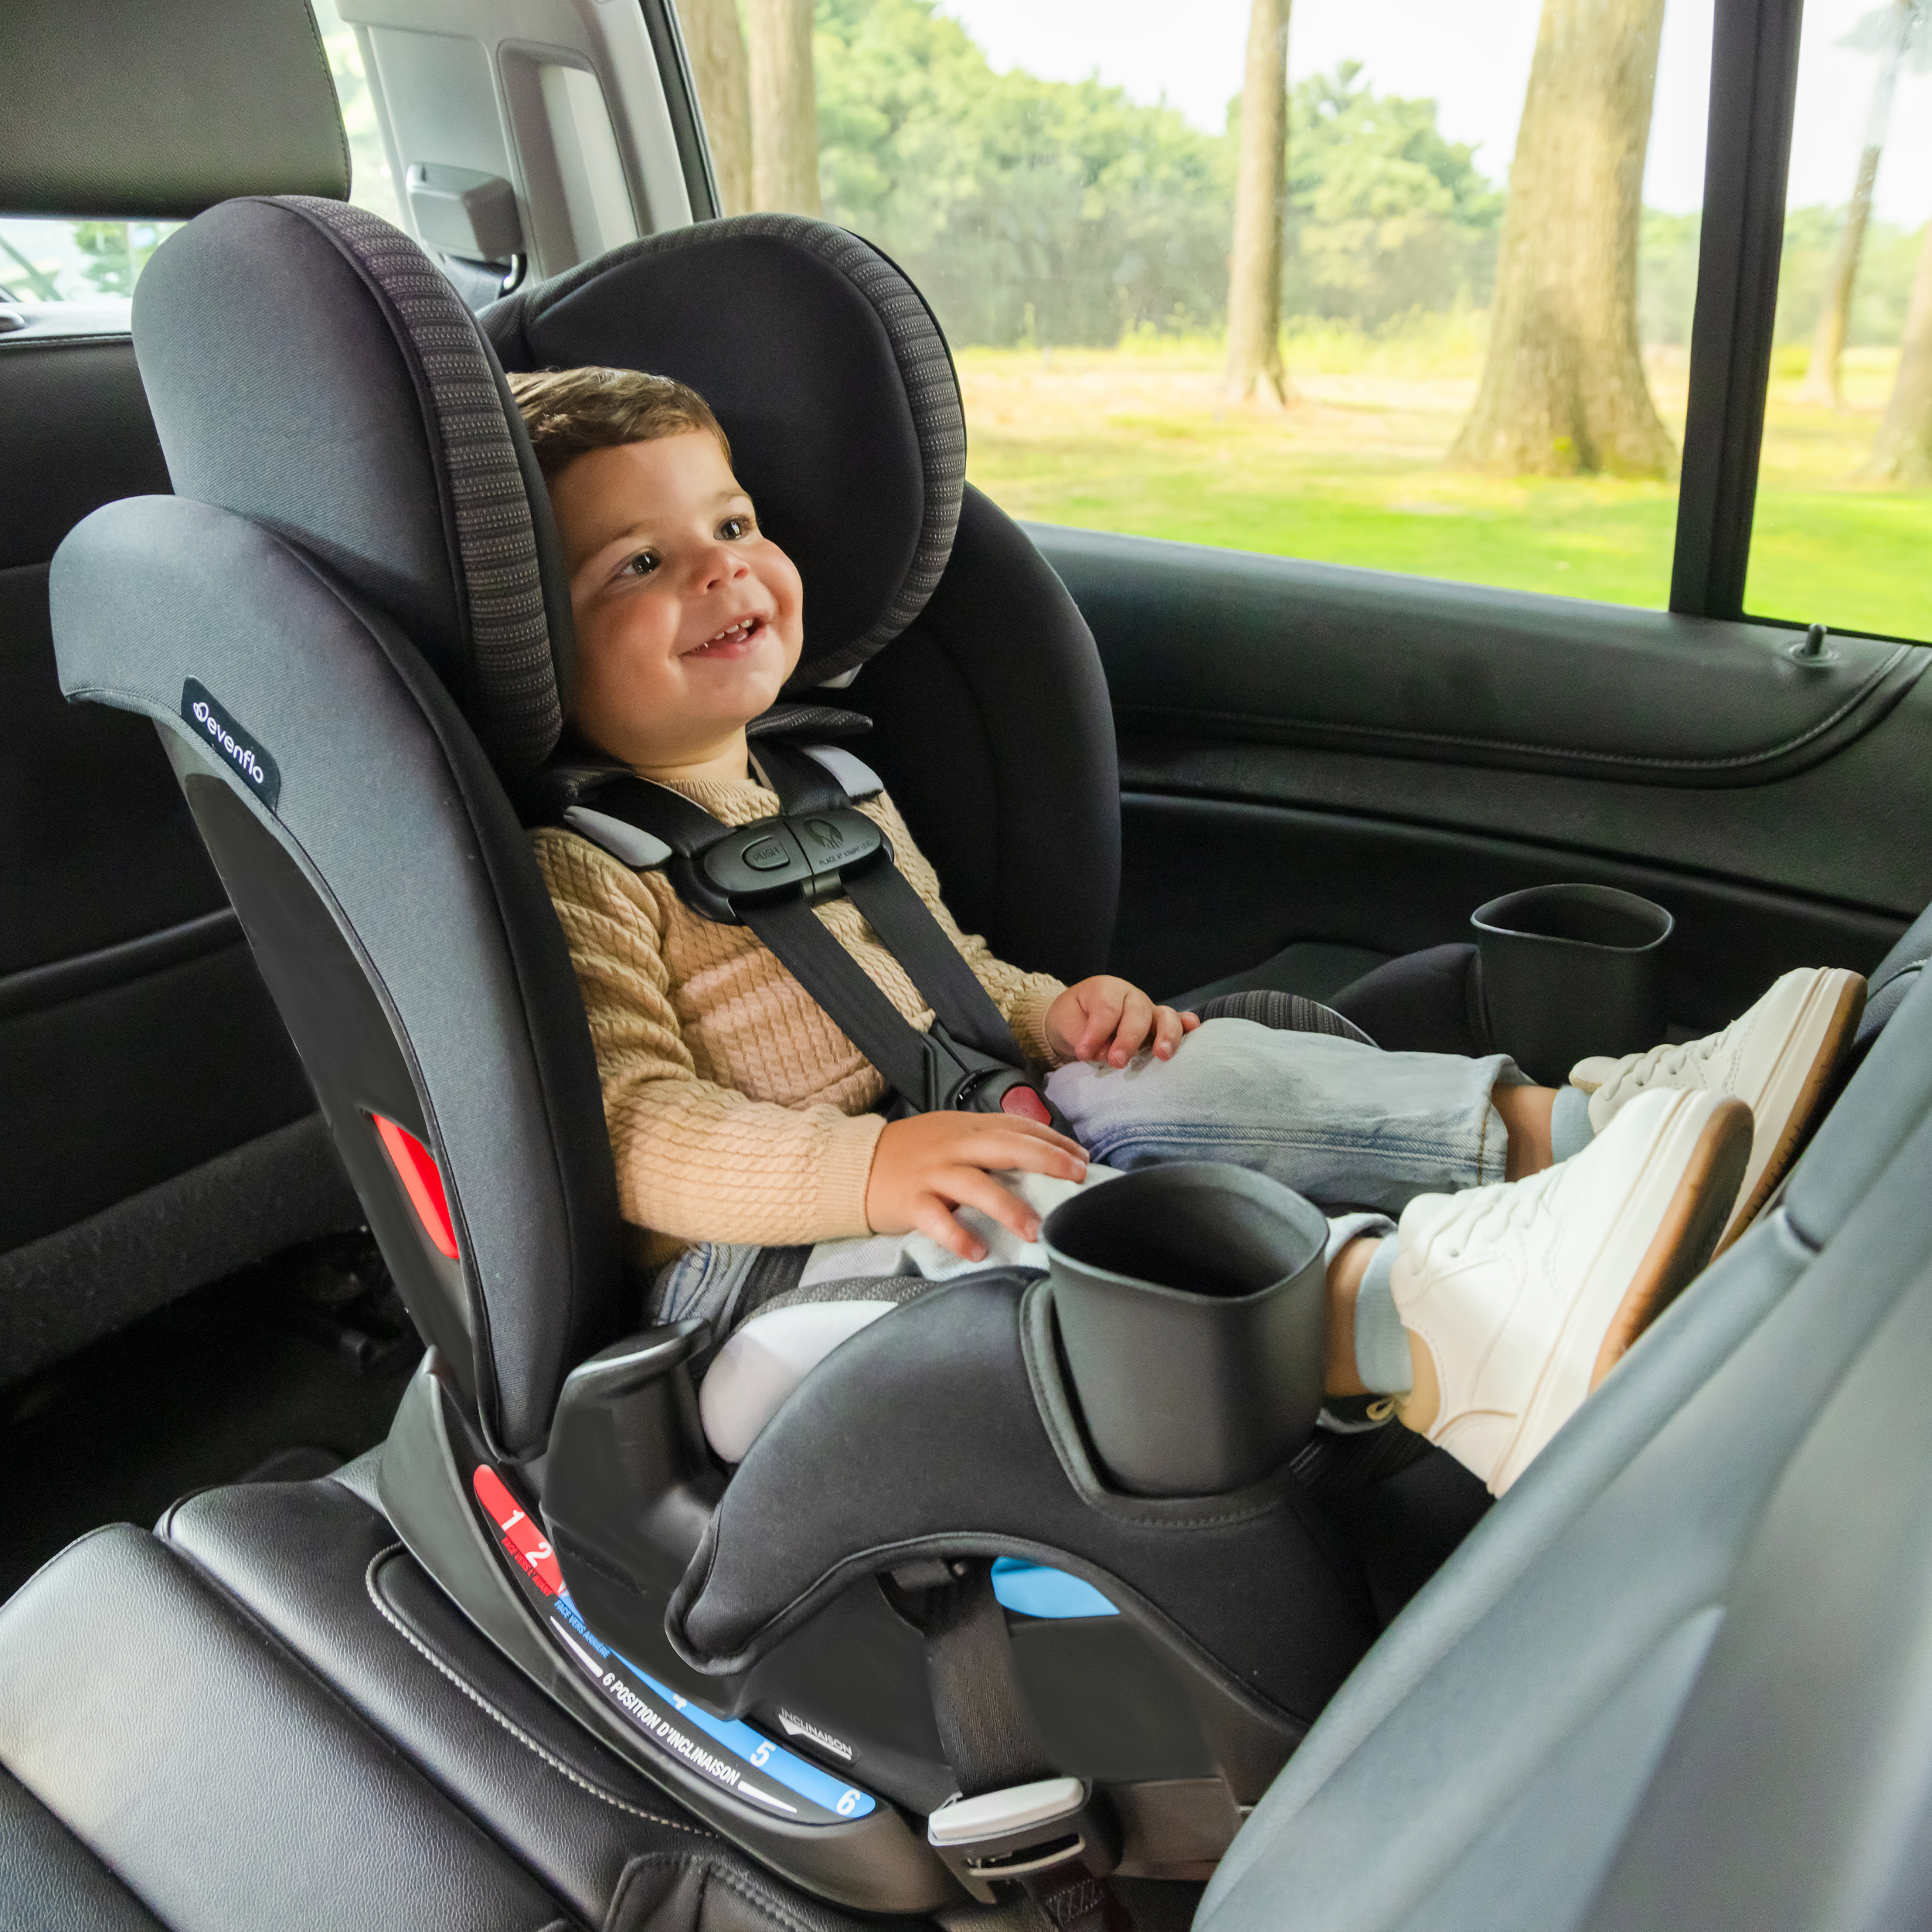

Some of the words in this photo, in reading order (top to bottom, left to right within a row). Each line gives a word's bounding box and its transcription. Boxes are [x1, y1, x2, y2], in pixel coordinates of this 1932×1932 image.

[206, 717, 264, 784] evenflo
[752, 846, 781, 862] PUSH
[502, 1509, 525, 1532] 1
[526, 1542, 552, 1568] 2
[502, 1536, 518, 1556] FACE
[514, 1552, 531, 1572] VERS
[553, 1600, 572, 1620] FACE
[569, 1614, 587, 1635] VERS
[602, 1672, 616, 1686] 6
[610, 1679, 662, 1730] POSITION
[656, 1721, 740, 1786] D'INCLINAISON
[781, 1706, 852, 1757] INCLINAISON
[750, 1740, 776, 1767] 5
[836, 1789, 861, 1815] 6
